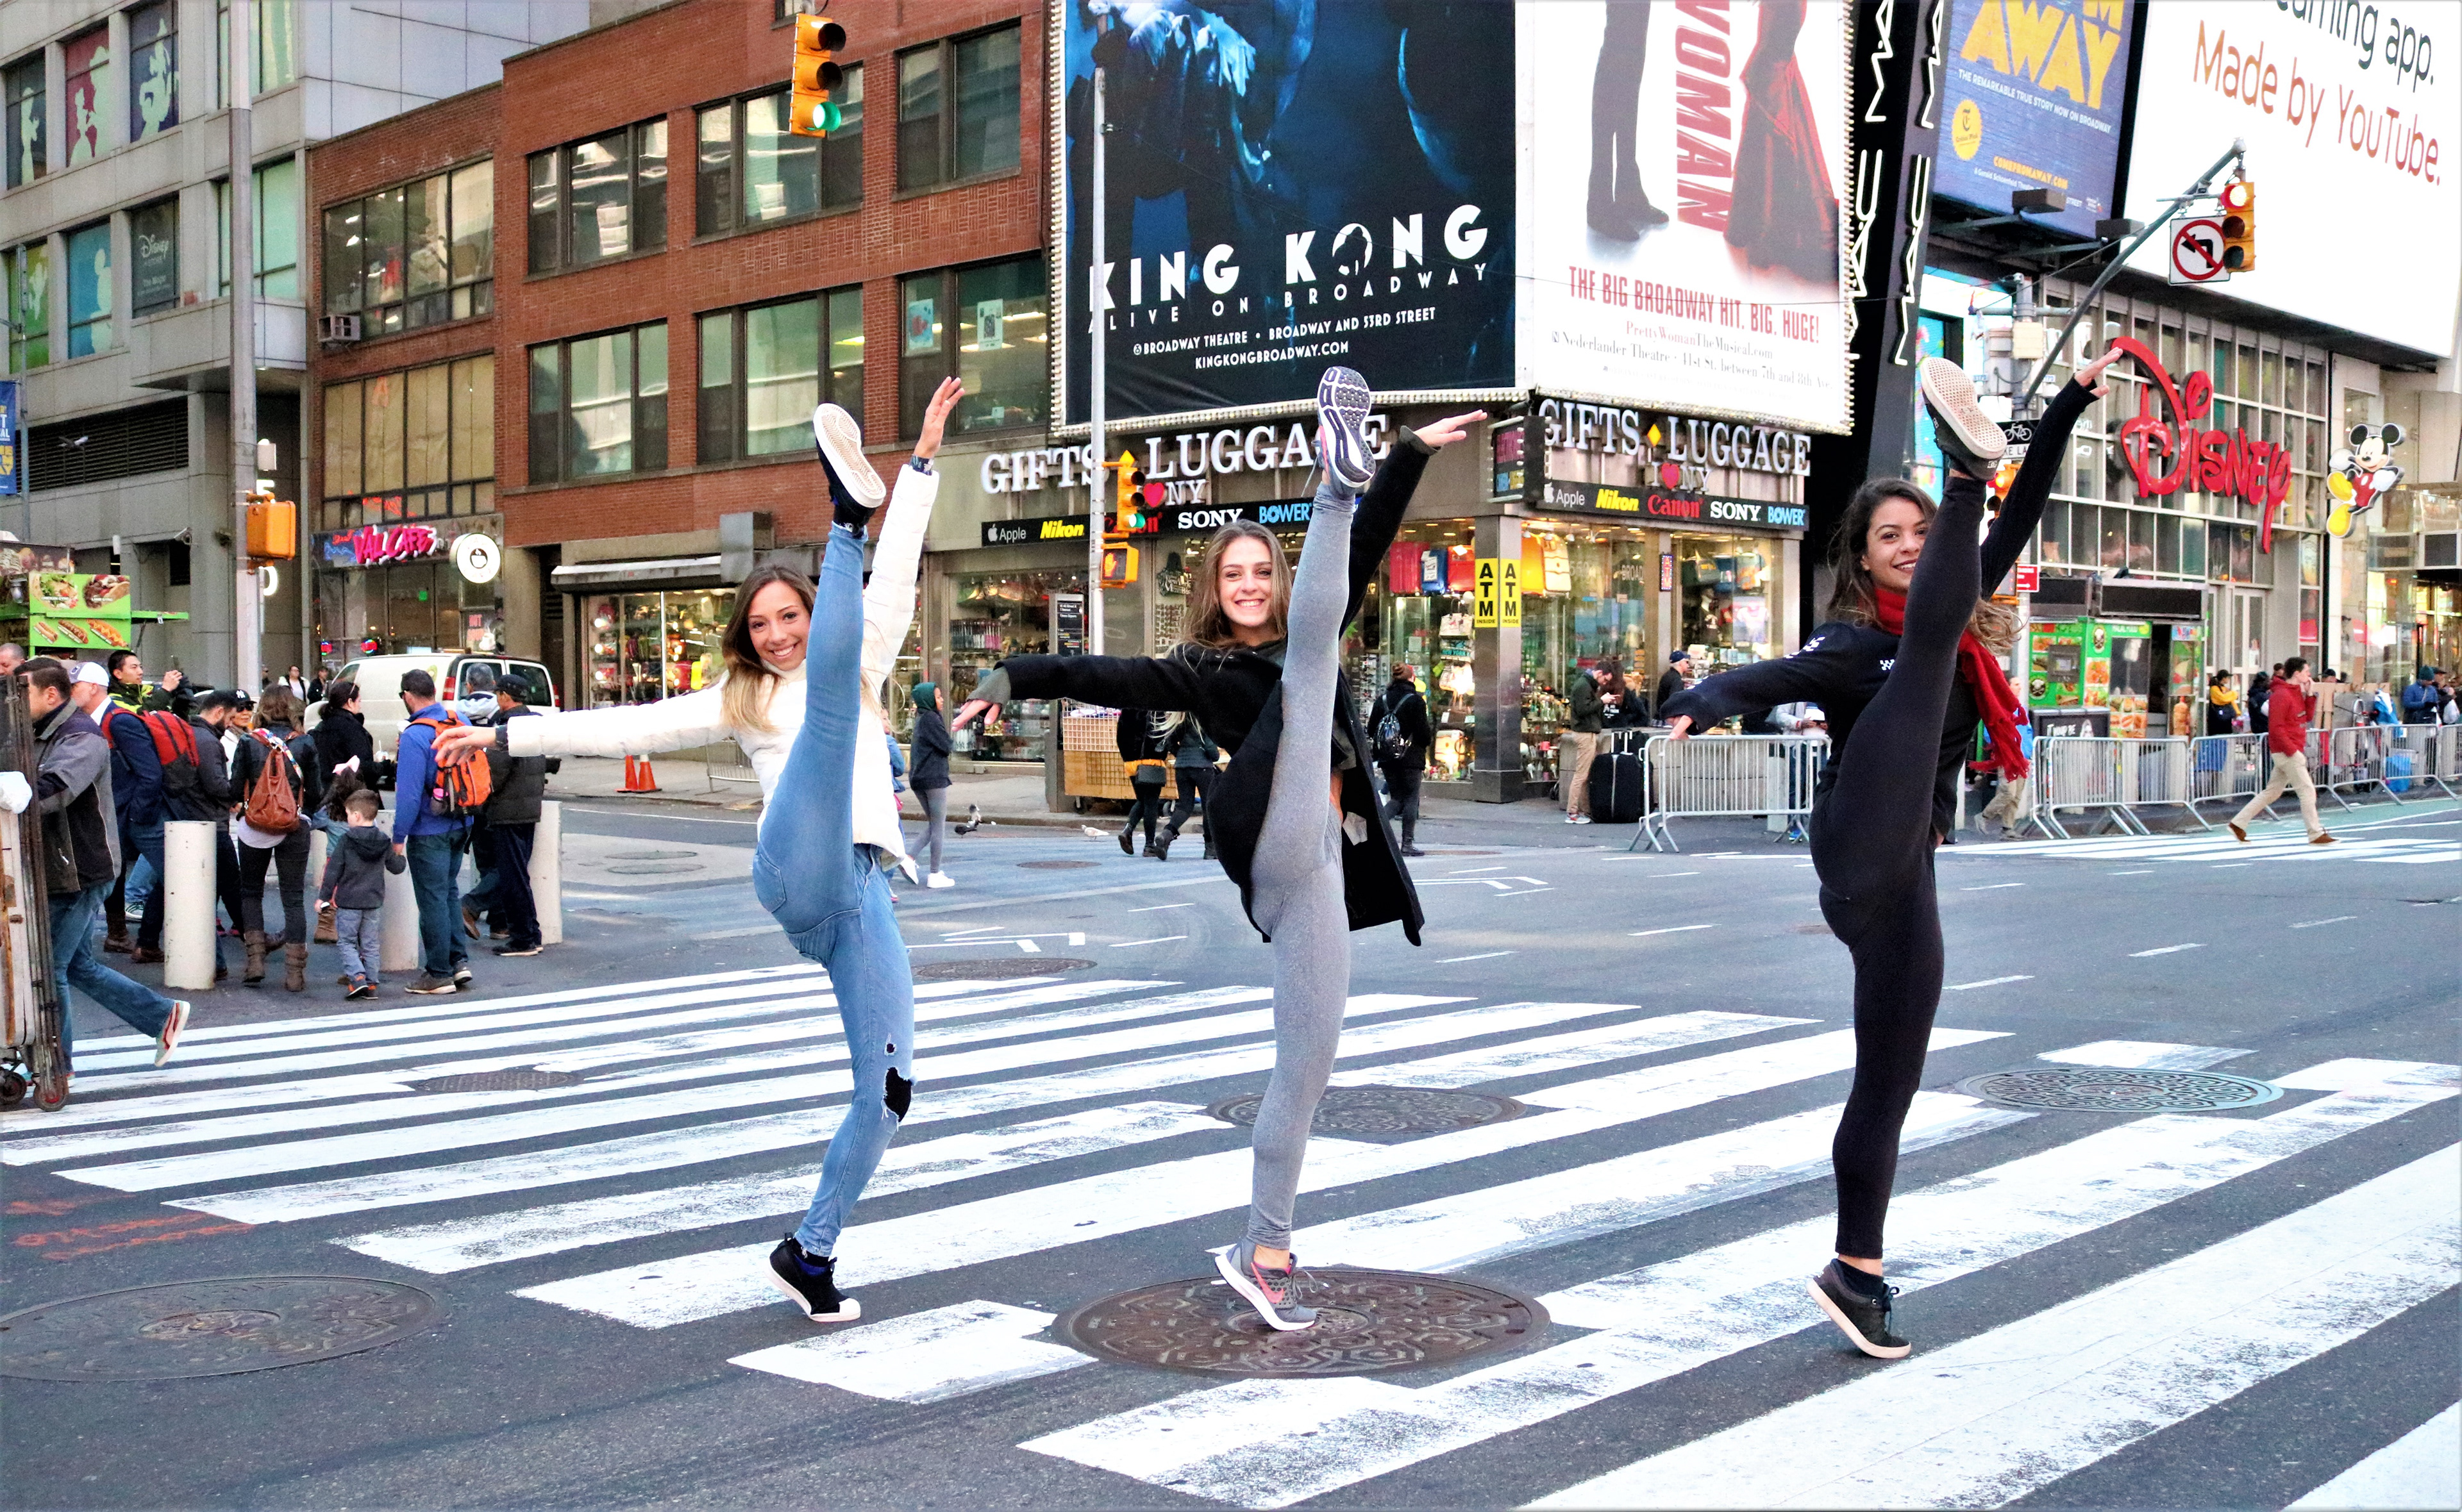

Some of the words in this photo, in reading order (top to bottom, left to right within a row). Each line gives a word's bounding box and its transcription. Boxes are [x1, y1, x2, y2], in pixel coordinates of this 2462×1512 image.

[1960, 0, 2121, 110] AWAY
[2386, 17, 2434, 93] app.
[1959, 69, 1971, 82] THE
[1973, 72, 2015, 98] REMARKABLE
[2016, 90, 2032, 104] TRUE
[2033, 96, 2054, 112] STORY
[2054, 104, 2069, 119] NOW
[2069, 111, 2079, 122] ON
[2079, 113, 2111, 134] BROADWAY
[2193, 19, 2277, 114] Made
[2287, 56, 2325, 148] by
[2338, 84, 2440, 187] YouTube.
[2066, 196, 2083, 208] STREET
[1089, 244, 1239, 312] KING
[1285, 204, 1487, 285] KONG
[1212, 297, 1248, 317] ON
[1284, 263, 1486, 308] BROADWAY
[1569, 266, 1596, 301] THE
[1603, 272, 1628, 308] BIG
[1634, 279, 1714, 323] BROADWAY
[1720, 296, 1745, 329] HIT.
[1751, 303, 1777, 336] BIG.
[1783, 309, 1820, 344] HUGE!
[1144, 336, 1202, 354] BROADWAY
[1203, 331, 1248, 347] THEATRE
[1269, 320, 1332, 340] BROADWAY
[1335, 317, 1359, 332] AND
[1364, 313, 1391, 328] 53RD
[1396, 307, 1436, 324] STREET
[1195, 341, 1348, 369] KINGKONGBROADWAY.COM
[1626, 320, 1773, 360] PrettyWomanTheMusical.com
[1563, 331, 1627, 357] Nederlander
[1630, 343, 1670, 363] Theatre
[1721, 359, 1758, 378] between
[1761, 365, 1776, 381] 7th
[1779, 369, 1795, 385] and
[1798, 372, 1813, 388] 8th
[1146, 414, 1391, 479] LUGGAE
[1539, 399, 1640, 456] GIFTS
[1668, 415, 1811, 477] LUGGAGE
[1166, 479, 1209, 506] NY
[1680, 464, 1714, 492] NY
[999, 527, 1026, 544] Apple
[1040, 520, 1085, 540] Nikon
[1178, 508, 1243, 529] SONY
[1259, 504, 1311, 524] BOWER
[1556, 490, 1586, 508] Apple
[1595, 488, 1639, 511] Nikon
[1647, 494, 1702, 519] Canon
[1710, 501, 1761, 522] SONY
[1768, 506, 1806, 526] BOWER
[385, 526, 437, 558] CAFE
[1479, 563, 1494, 617] ATM
[1504, 563, 1517, 617] ATM
